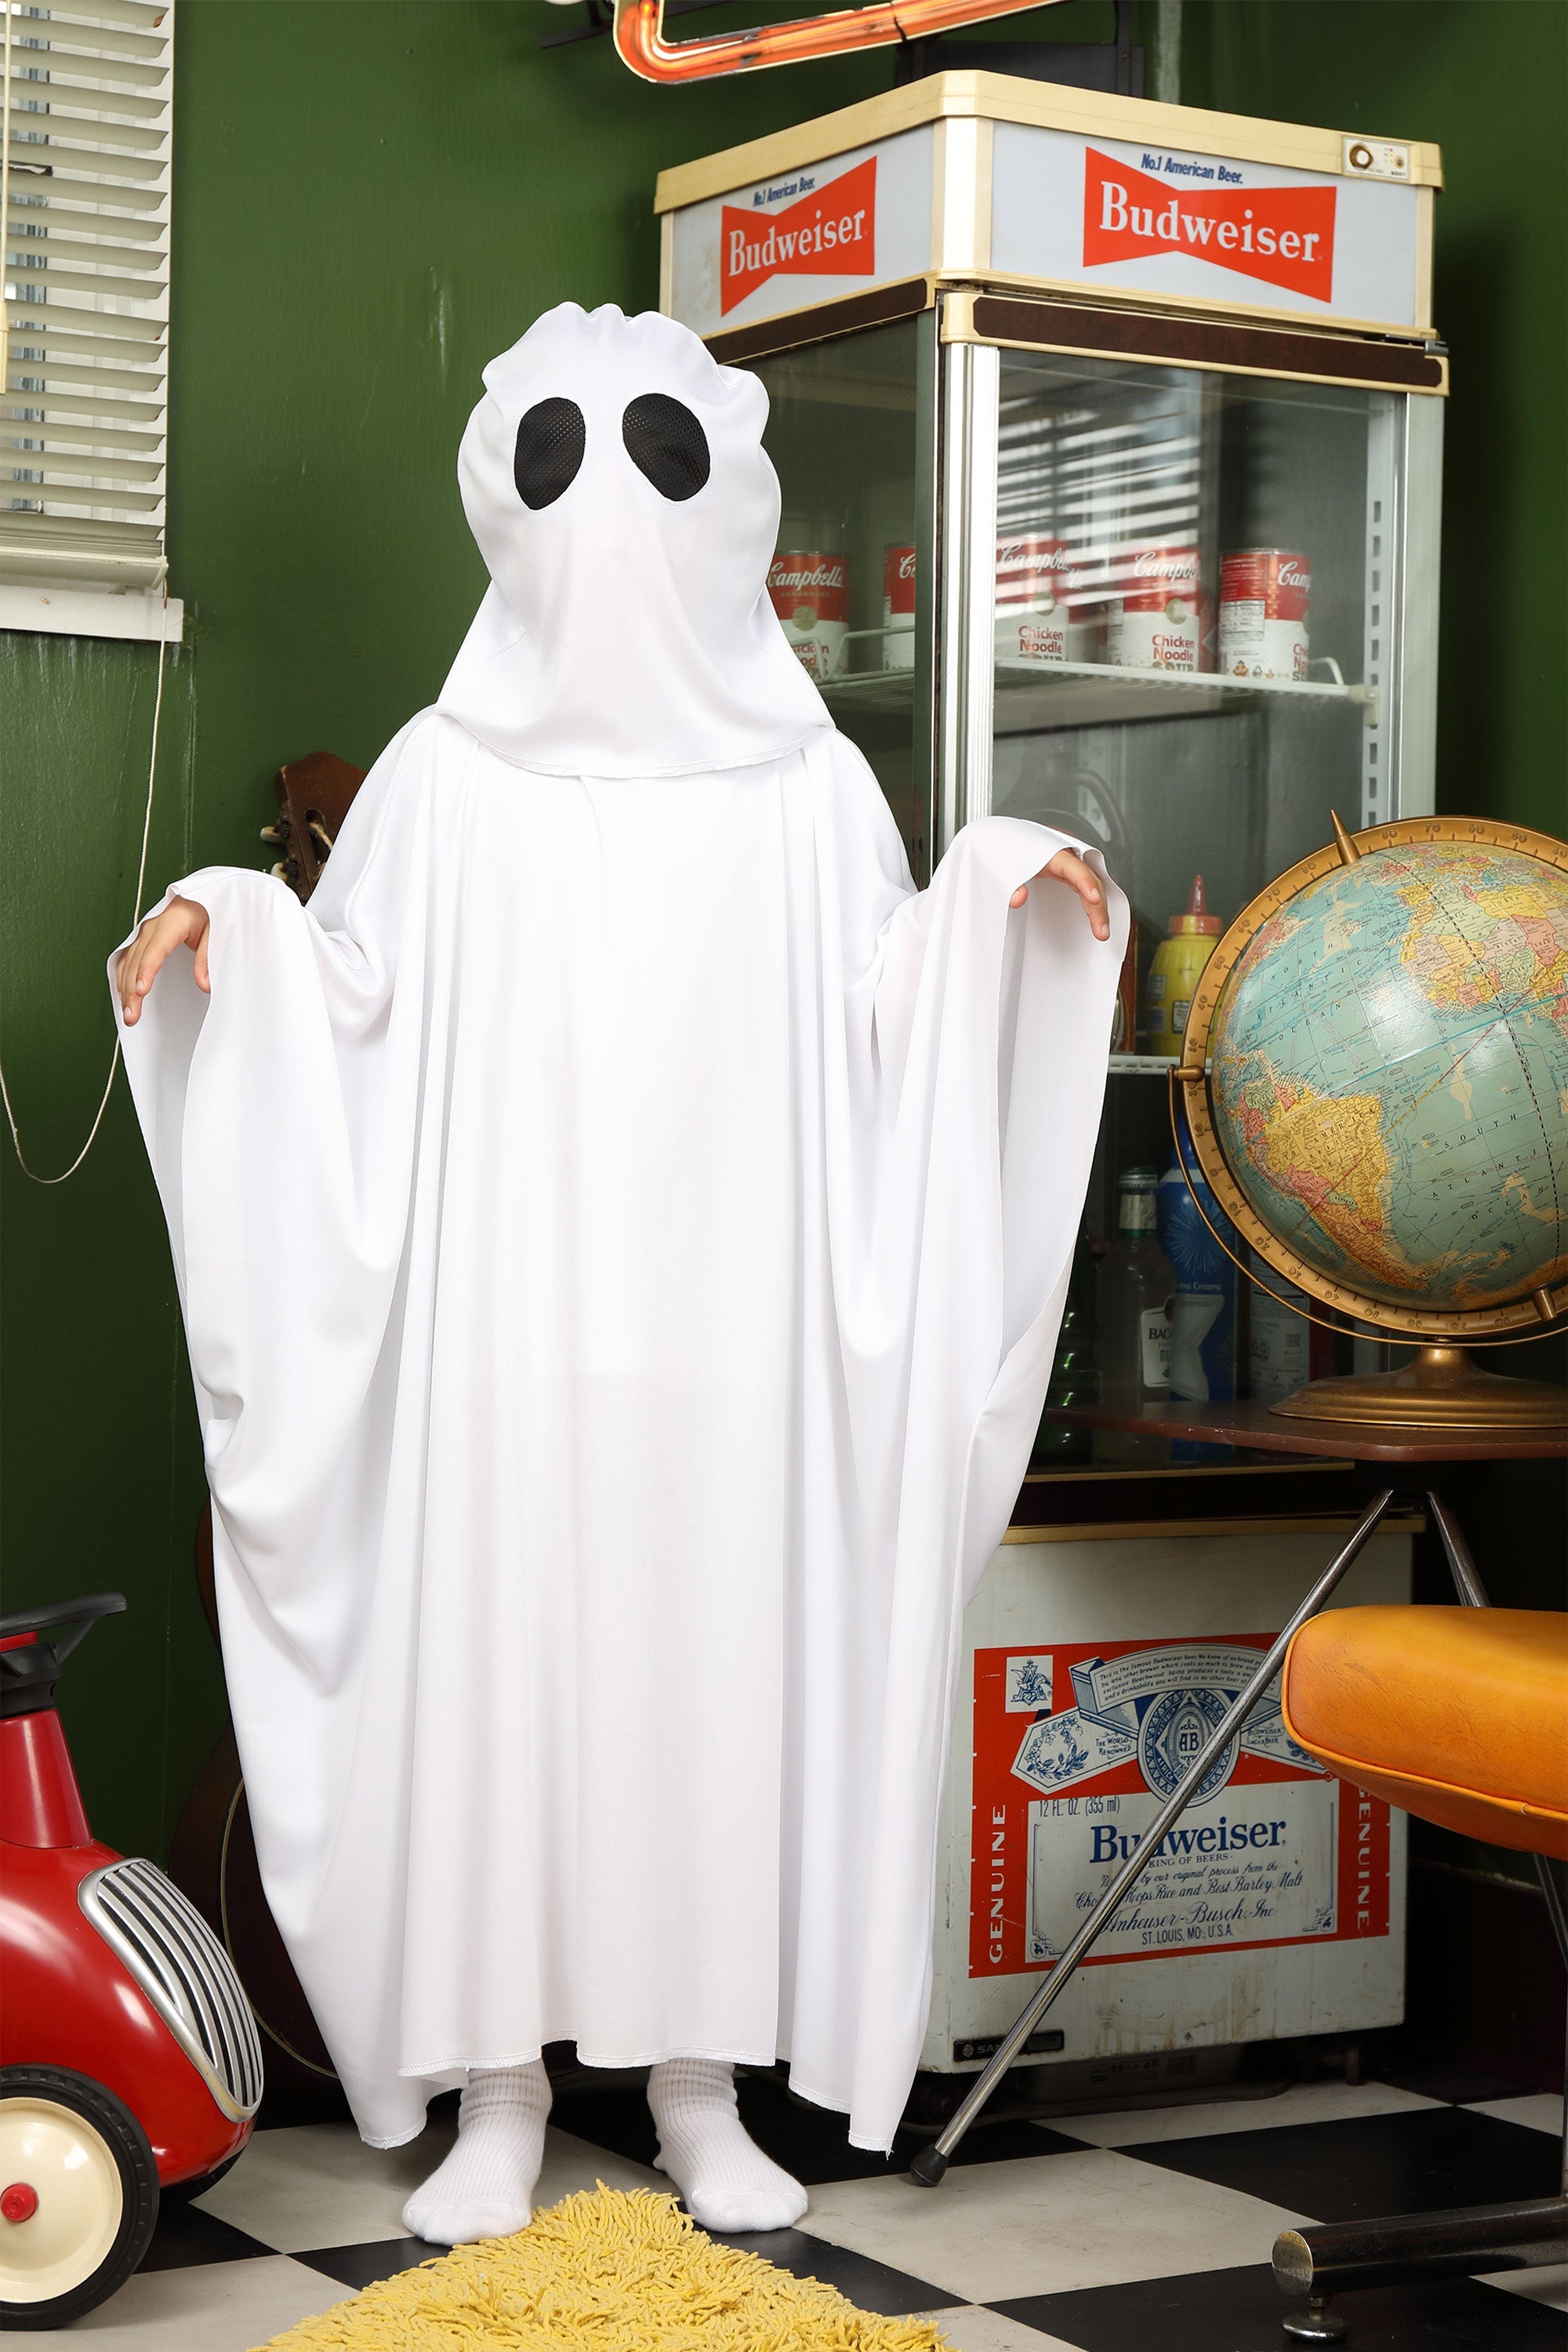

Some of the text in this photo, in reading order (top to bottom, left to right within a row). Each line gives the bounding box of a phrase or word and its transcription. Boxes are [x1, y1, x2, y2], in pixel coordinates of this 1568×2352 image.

[1141, 153, 1243, 183] No.1 American Beer.
[767, 183, 797, 201] American
[1099, 180, 1321, 263] Budweiser
[729, 209, 866, 277] Budweiser
[1018, 626, 1064, 641] Chicken
[1152, 634, 1195, 649] Chicken
[1020, 639, 1062, 653] Noodle
[1153, 647, 1194, 662] Noodle
[1425, 823, 1440, 833] 70
[1468, 824, 1485, 833] 60
[1511, 831, 1526, 843] 50
[1266, 887, 1281, 901] 70
[1213, 955, 1225, 970] 50
[1444, 1113, 1517, 1149] SOUTH
[1432, 1142, 1554, 1199] ATLANTIC
[1472, 1186, 1544, 1221] OCEAN
[1193, 1282, 1222, 1292] Creamy
[1179, 1732, 1200, 1751] AB
[1157, 1757, 1174, 1781] AFRICA
[1040, 1800, 1048, 1817] 12
[1068, 1798, 1080, 1815] OZ.
[1085, 1796, 1104, 1817] (355
[1149, 1853, 1229, 1868] KING OF BEERS
[1141, 1875, 1151, 1886] by
[1173, 1865, 1206, 1883] original
[1207, 1865, 1240, 1879] process
[1242, 1860, 1263, 1875] from
[1265, 1860, 1279, 1871] the
[1178, 1885, 1201, 1898] and
[1203, 1878, 1231, 1895] Best
[1231, 1875, 1272, 1895] Barley
[1273, 1867, 1304, 1890] Malt
[989, 1805, 1006, 1964] GENUINE
[1142, 1931, 1156, 1945] ST.
[1156, 1928, 1185, 1944] LOUIS,
[1208, 1923, 1234, 1937] U.S.A.
